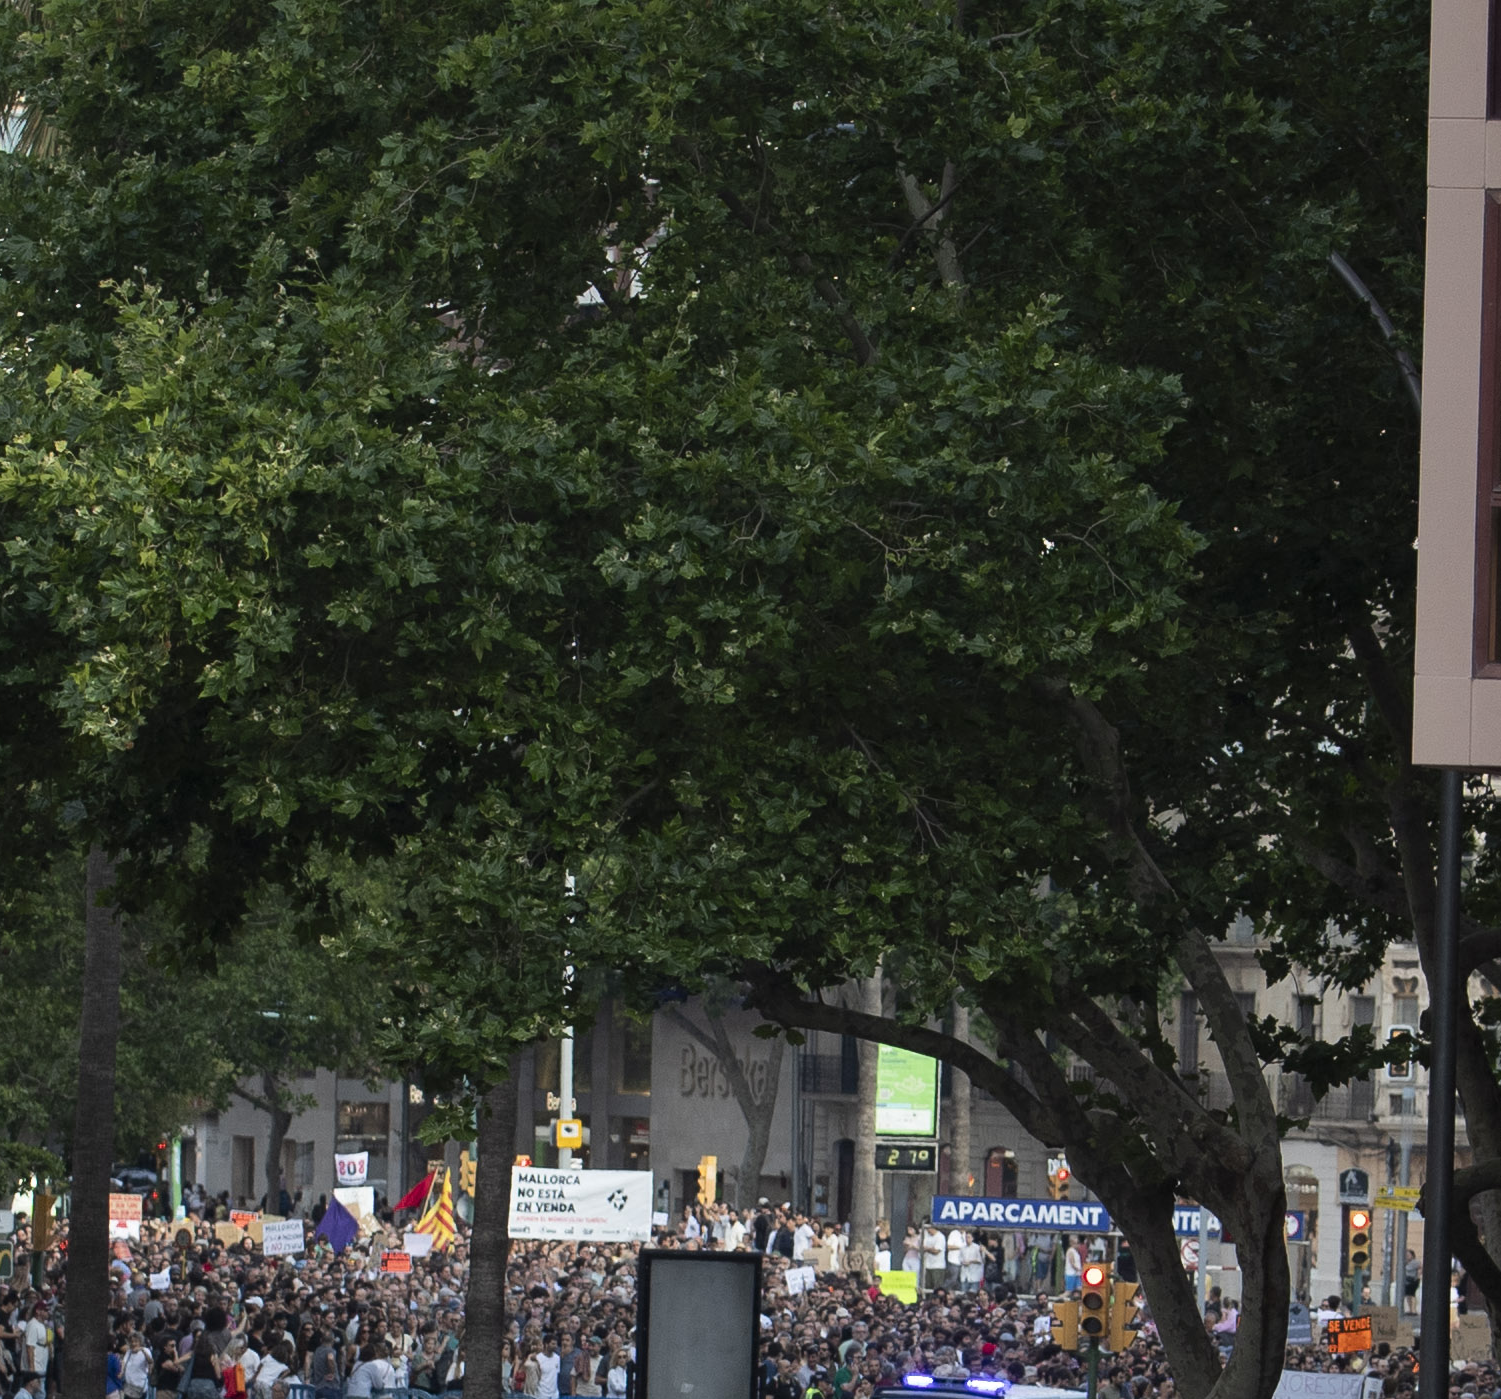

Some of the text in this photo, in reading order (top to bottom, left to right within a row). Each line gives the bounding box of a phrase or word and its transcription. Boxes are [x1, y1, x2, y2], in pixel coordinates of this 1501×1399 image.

[518, 1174, 581, 1185] MALLORCA
[517, 1188, 534, 1198] NO
[516, 1202, 576, 1213] EN VENDA
[940, 1200, 1103, 1227] APARCAMENT
[1328, 1321, 1340, 1333] SE
[1343, 1316, 1371, 1331] VENDE
